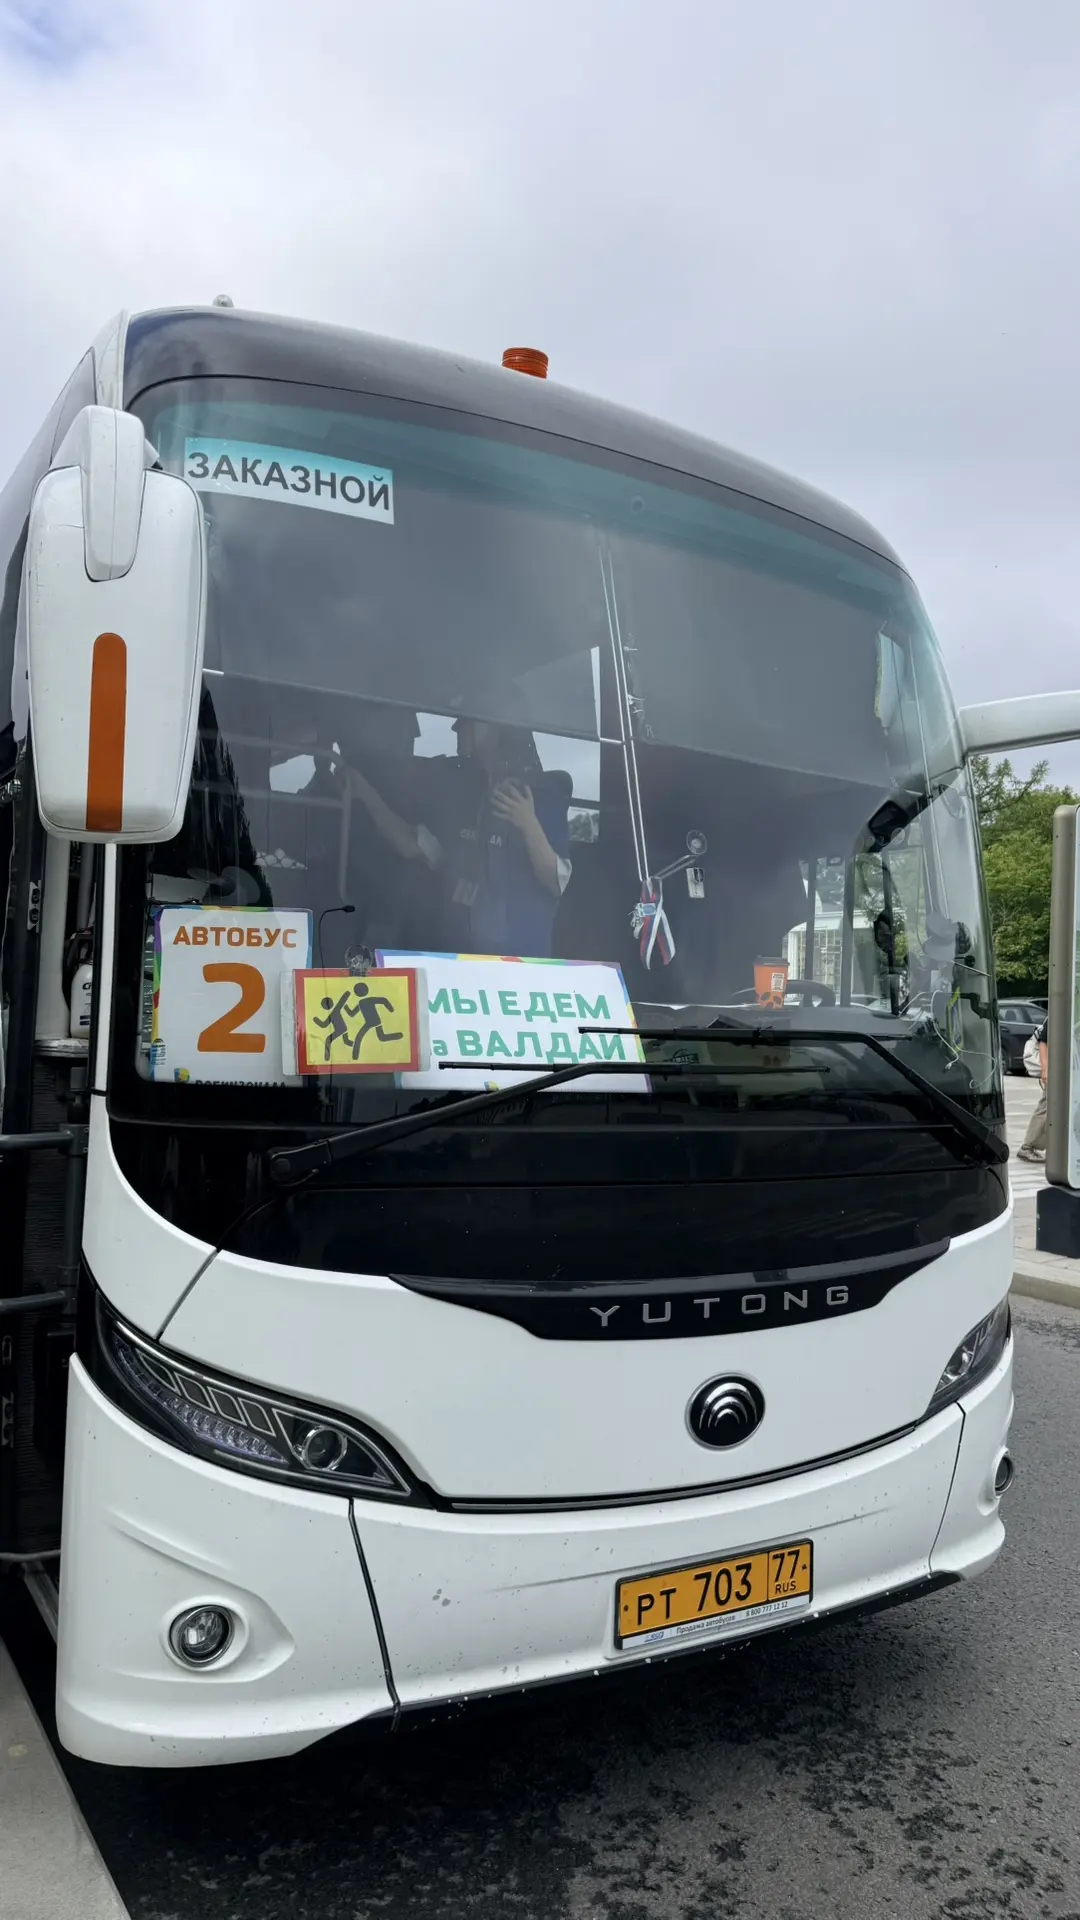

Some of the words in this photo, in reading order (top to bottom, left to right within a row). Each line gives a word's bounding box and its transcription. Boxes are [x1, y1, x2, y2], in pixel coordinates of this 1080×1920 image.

[187, 452, 390, 511] ЗАКАЗНОЙ
[173, 925, 298, 948] АВТОБУС
[197, 962, 266, 1053] 2
[428, 988, 490, 1015] МЫ
[497, 990, 611, 1023] ЕДЕМ
[431, 1039, 449, 1057] а
[589, 1285, 849, 1327] YUTONG
[693, 1562, 752, 1612] 703
[772, 1549, 800, 1583] 77
[775, 1580, 797, 1595] RUS
[751, 1607, 762, 1616] 800
[762, 1605, 772, 1613] 777
[773, 1602, 780, 1610] 12
[781, 1600, 788, 1608] 12
